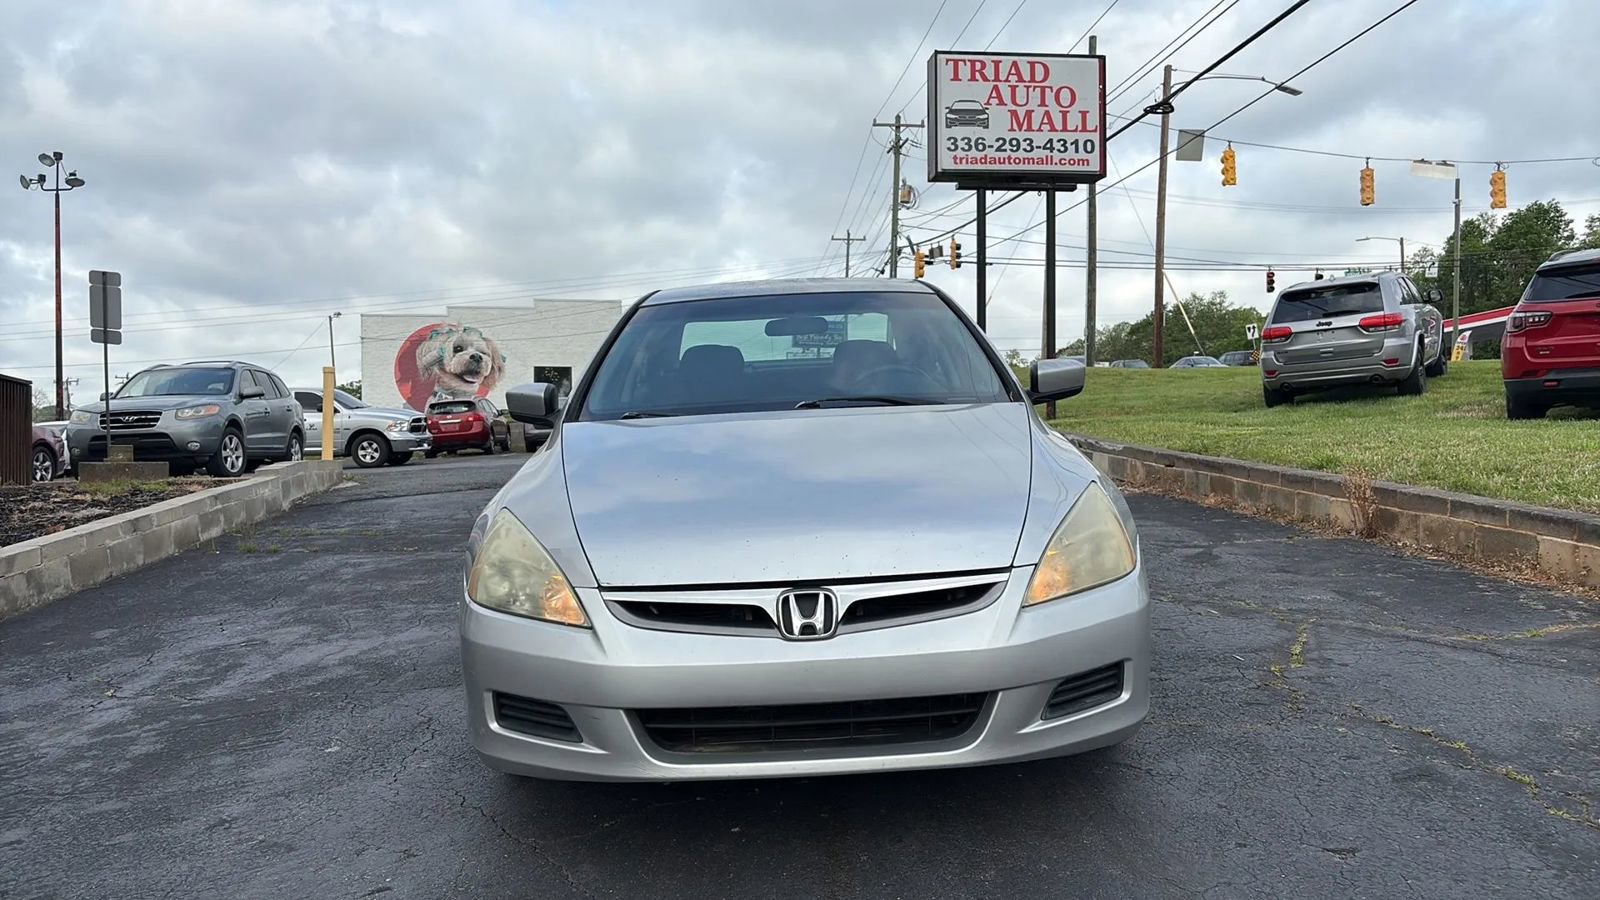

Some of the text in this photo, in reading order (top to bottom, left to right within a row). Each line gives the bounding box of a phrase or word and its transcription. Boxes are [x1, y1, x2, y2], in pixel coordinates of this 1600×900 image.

[945, 58, 1050, 84] TRIAD
[984, 84, 1077, 108] AUTO
[1008, 109, 1098, 133] MALL
[946, 136, 1096, 154] 336-293-4310
[952, 154, 1090, 167] triadautomall.com
